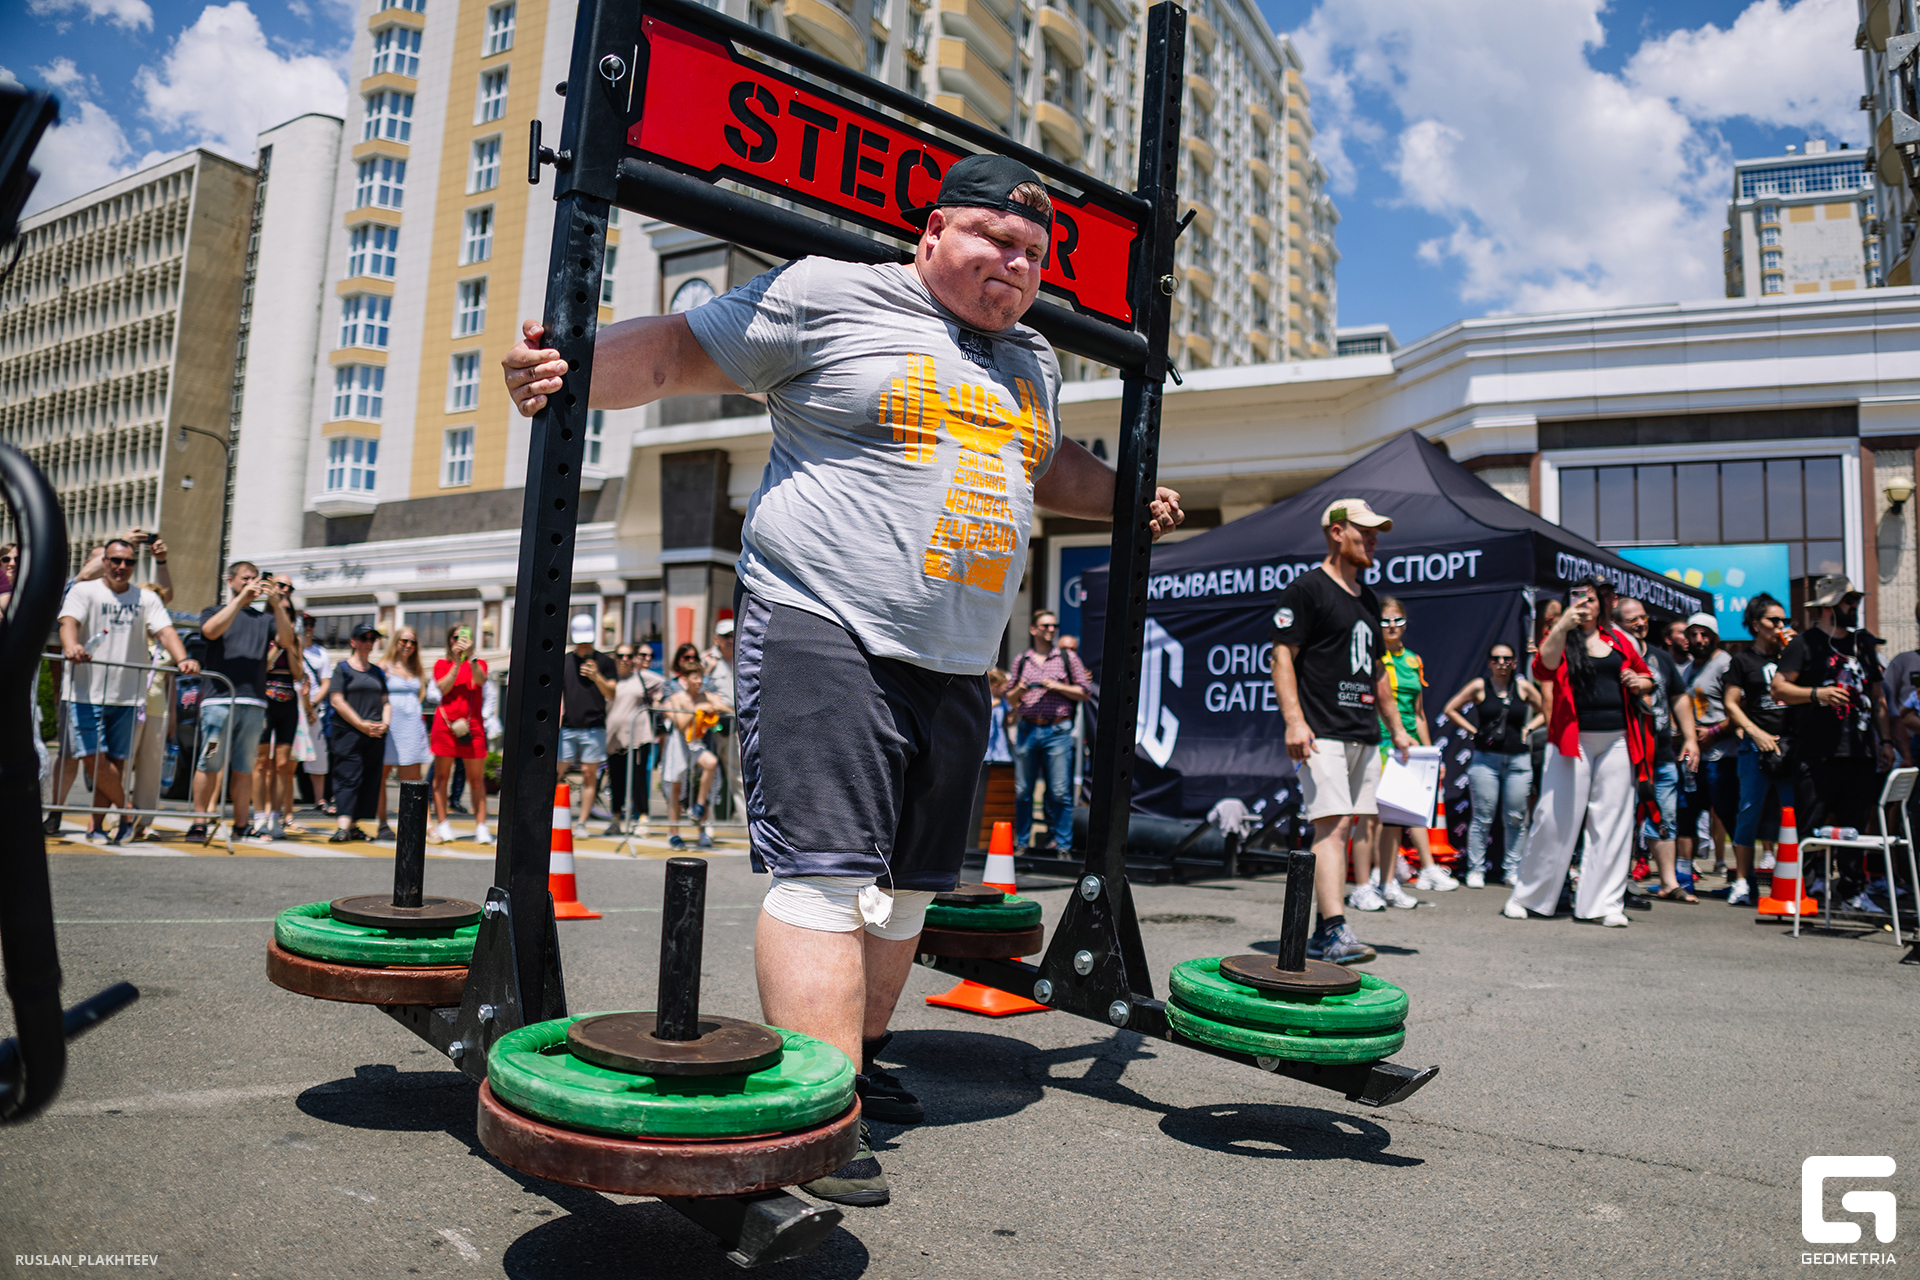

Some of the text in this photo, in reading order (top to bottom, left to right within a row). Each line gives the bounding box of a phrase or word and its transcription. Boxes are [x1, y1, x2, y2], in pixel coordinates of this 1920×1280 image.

[724, 80, 1079, 281] STECR
[957, 450, 1005, 473] САМЫЙ
[953, 466, 1008, 494] СИЛЬНЫЙ
[944, 487, 1014, 522] ЧЕЛОВЕК
[929, 514, 1017, 553] КУБАНИ
[1147, 566, 1255, 600] КРЫВАЕМ
[1385, 549, 1483, 584] СПОРТ
[1207, 642, 1274, 676] ORIG
[1204, 681, 1279, 713] GATE
[1338, 691, 1360, 703] GATE
